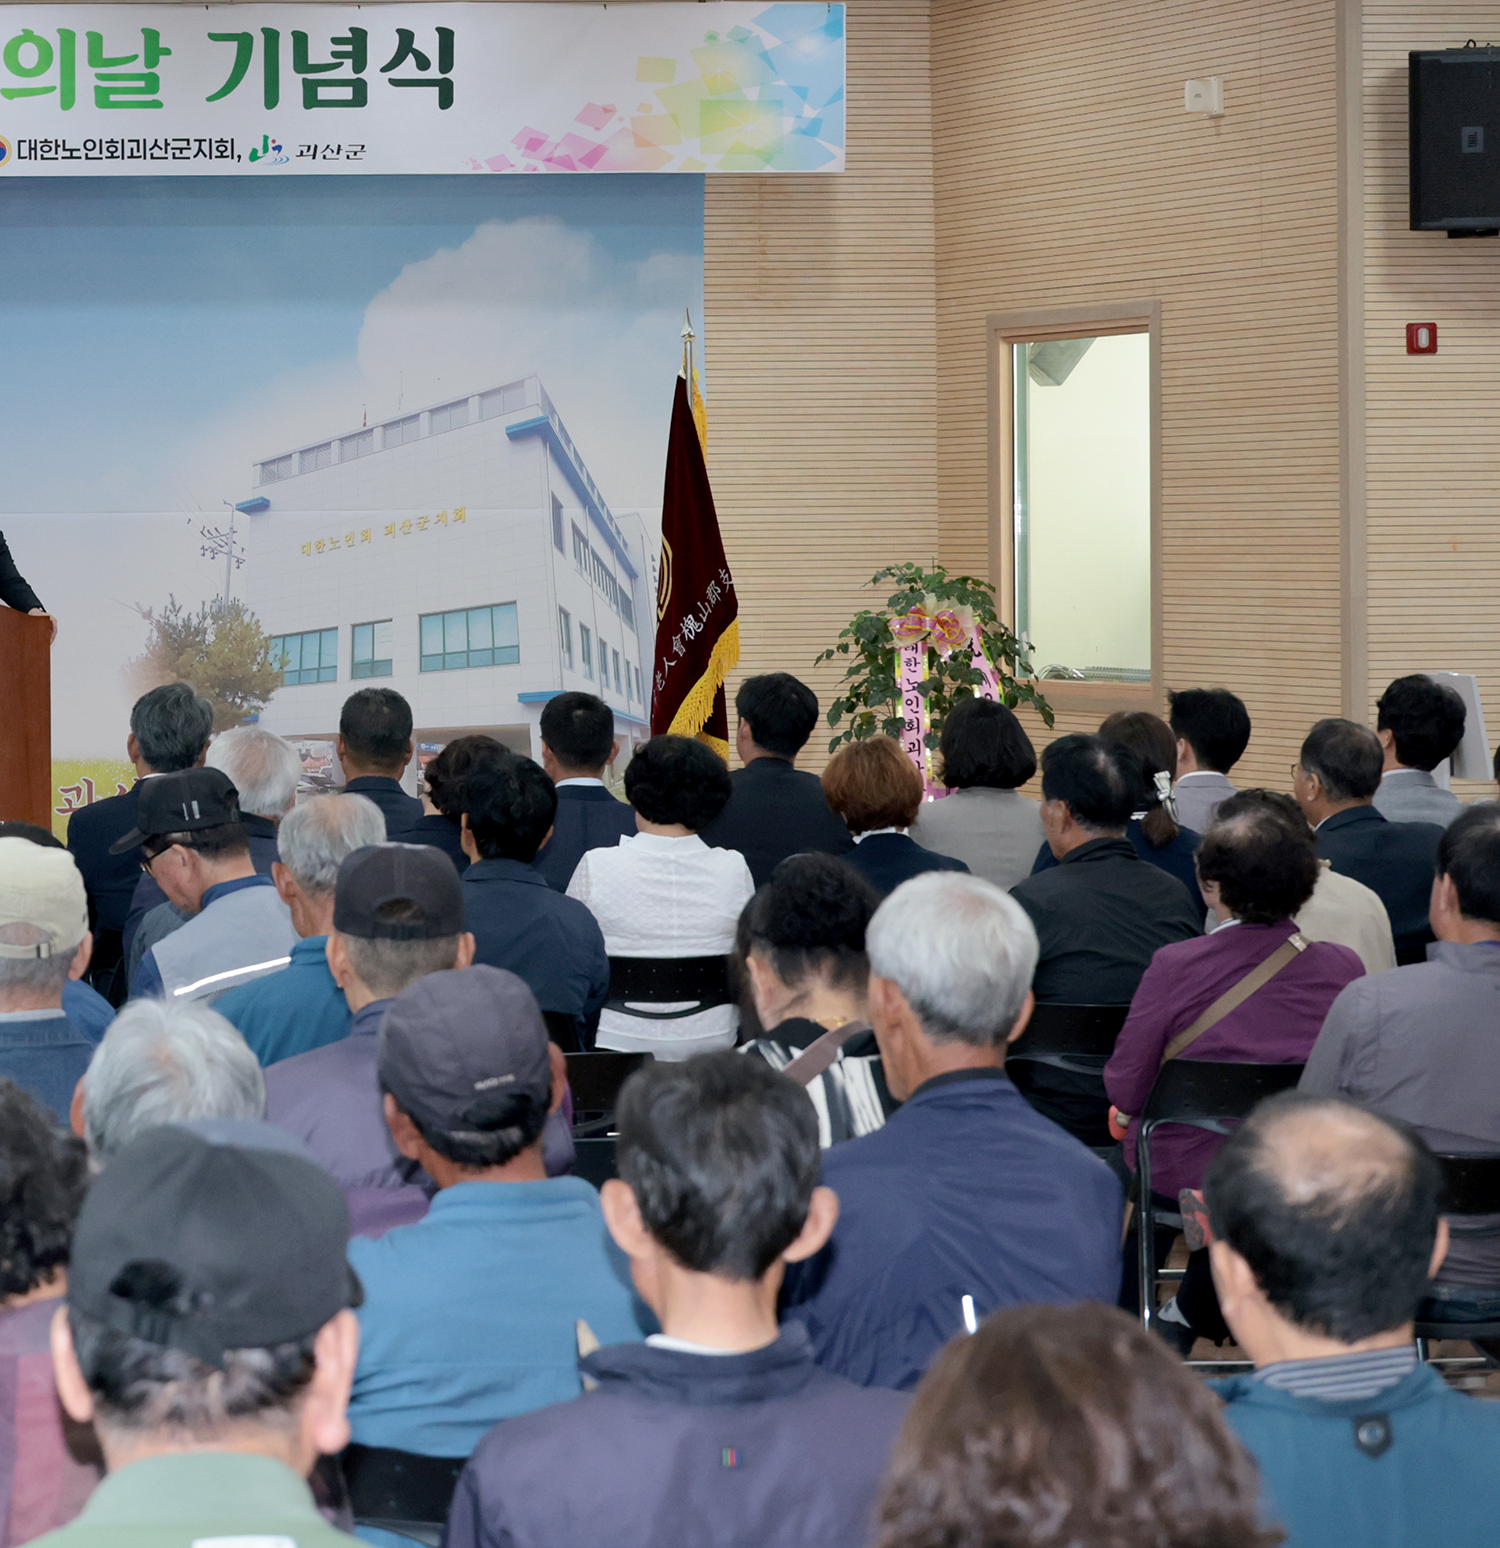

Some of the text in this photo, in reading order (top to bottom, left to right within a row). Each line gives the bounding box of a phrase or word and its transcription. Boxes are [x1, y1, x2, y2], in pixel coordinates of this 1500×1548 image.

[205, 26, 456, 111] 기념식
[17, 137, 242, 163] 대한노인회괴산군지회,
[295, 143, 367, 160] 괴산군
[301, 507, 467, 556] 대한노인회 괴산군지회
